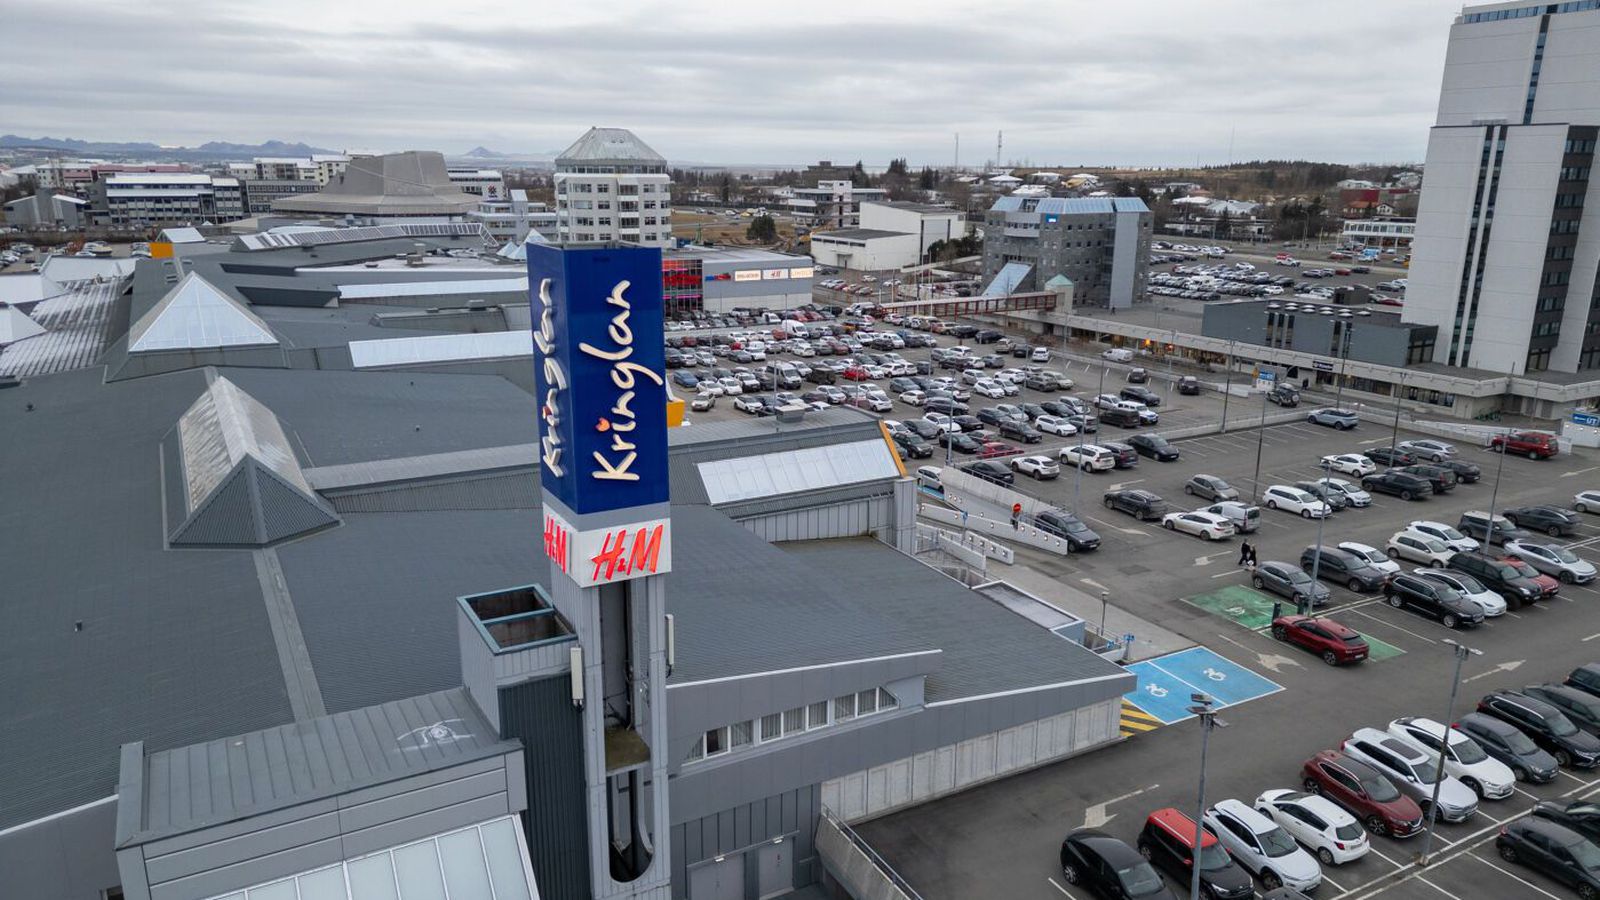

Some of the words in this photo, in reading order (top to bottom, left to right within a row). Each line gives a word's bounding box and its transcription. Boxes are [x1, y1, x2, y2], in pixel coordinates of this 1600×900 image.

[533, 278, 567, 478] Kringlan
[578, 280, 663, 480] Kringlan
[543, 514, 567, 575] H&M
[590, 524, 663, 581] H&M
